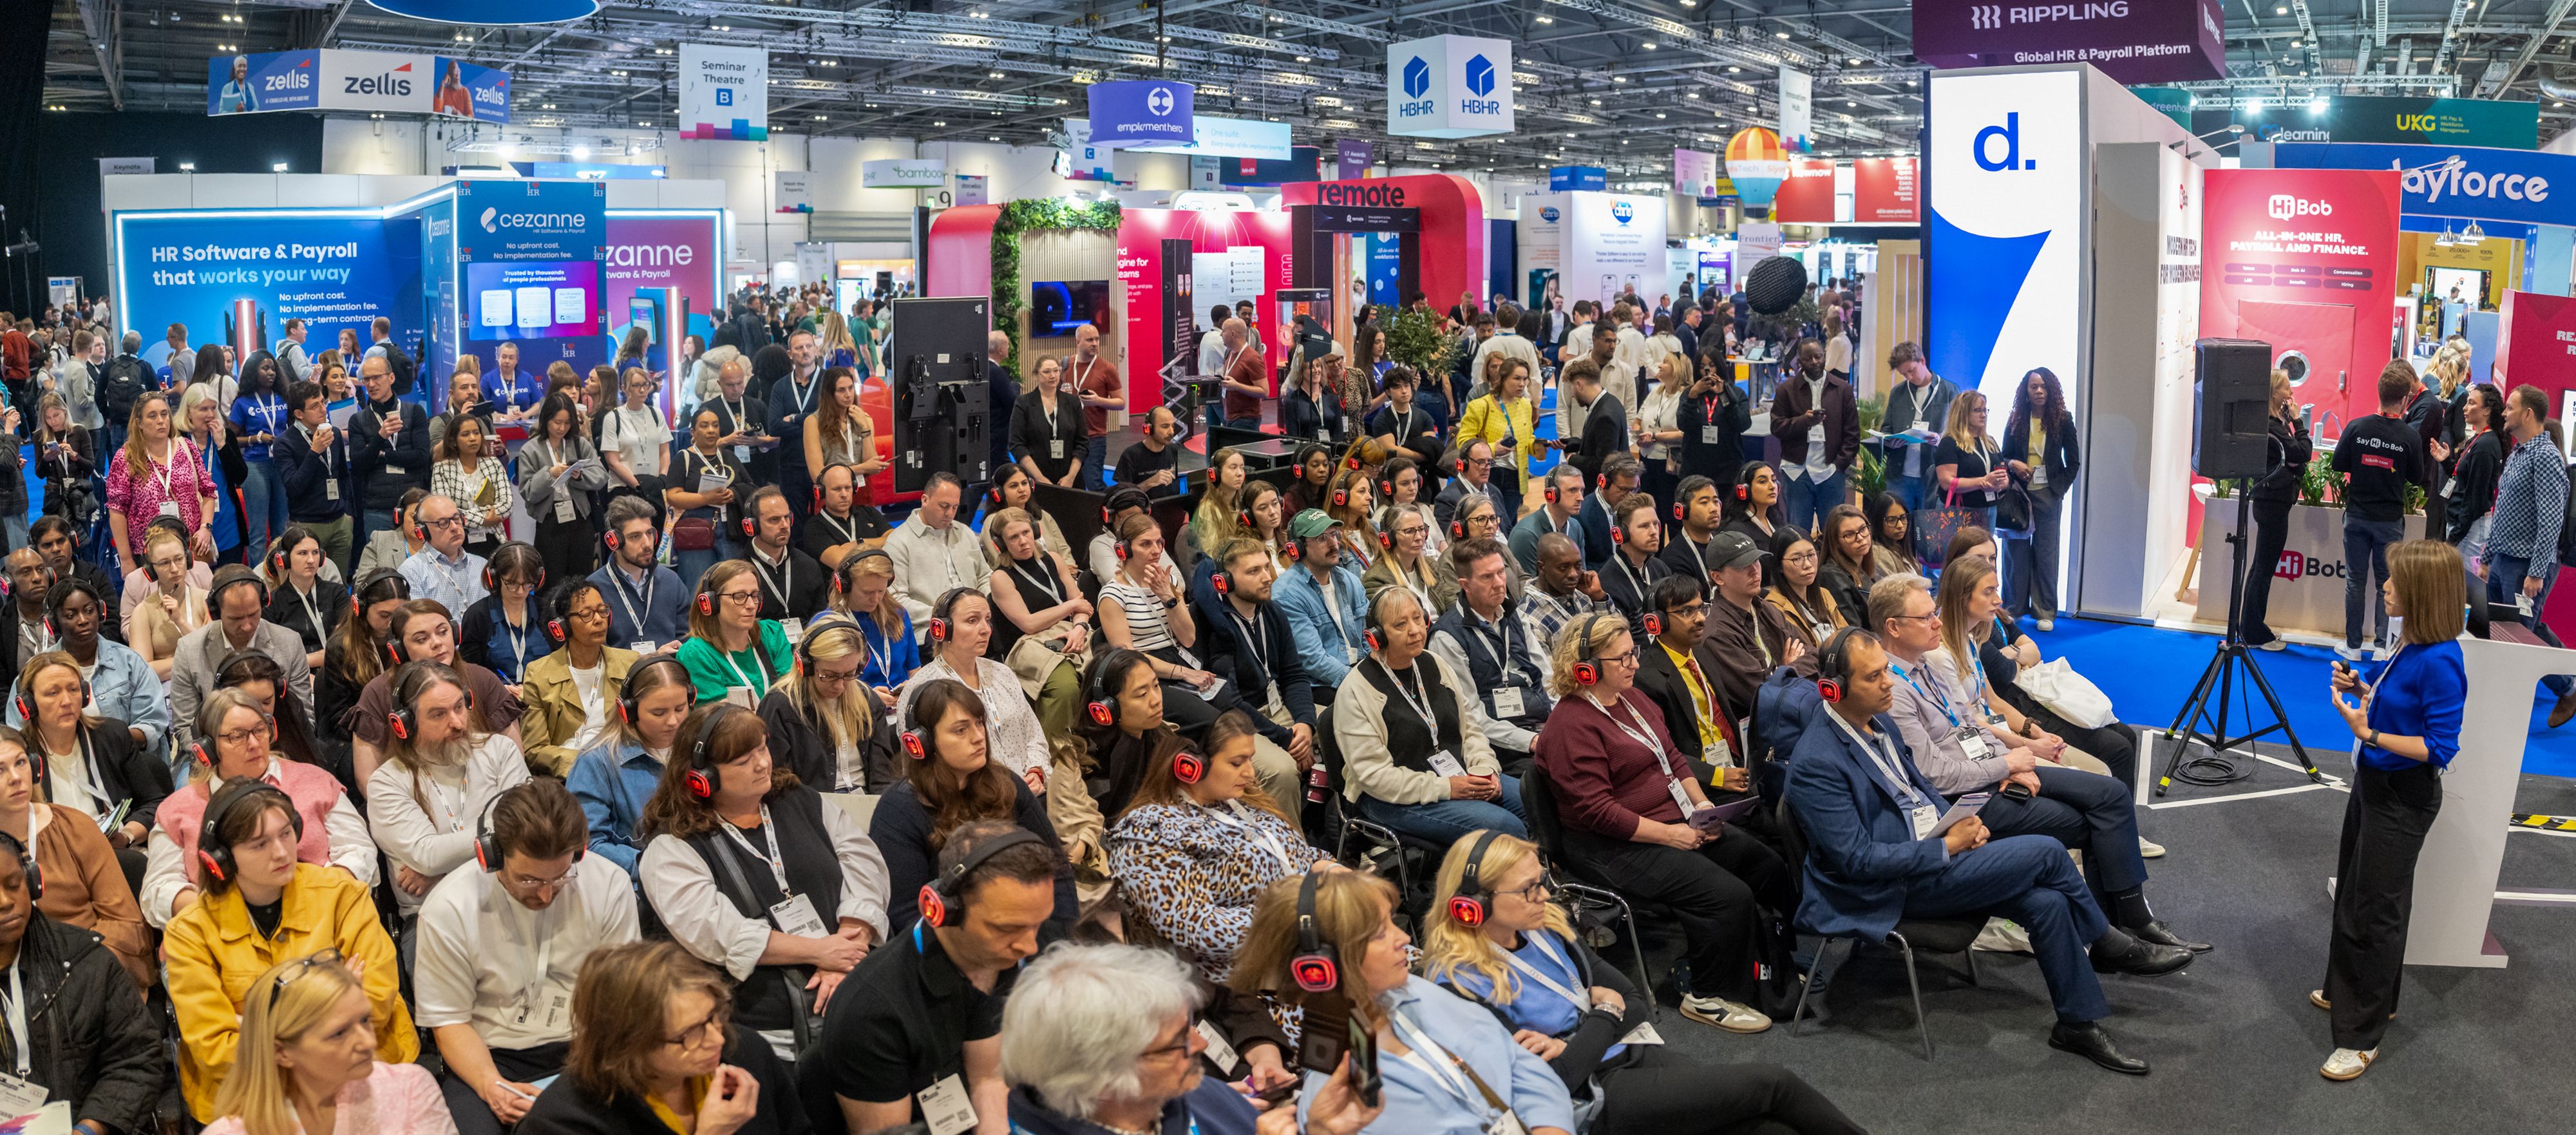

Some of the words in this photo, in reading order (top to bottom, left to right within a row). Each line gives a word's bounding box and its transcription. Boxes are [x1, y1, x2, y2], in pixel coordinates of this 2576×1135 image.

[2010, 1, 2128, 24] RIPPLING
[2014, 52, 2054, 63] Global
[2057, 50, 2075, 61] HR
[2079, 50, 2088, 61] &
[2090, 46, 2132, 62] Payroll
[2136, 44, 2190, 57] Platform
[702, 61, 746, 73] Seminar
[265, 68, 310, 91] zellis
[345, 72, 412, 96] zellis
[703, 73, 745, 85] Theatre
[475, 85, 504, 106] zellis
[719, 91, 730, 104] B
[1400, 100, 1434, 117] HBHR
[1463, 99, 1500, 115] HBHR
[2396, 114, 2436, 131] UKG
[1973, 111, 2036, 172] d.
[2388, 158, 2548, 204] ayforce
[940, 191, 951, 207] 9
[1318, 183, 1405, 207] remote
[2269, 195, 2333, 220] HiBob
[432, 218, 450, 237] cezanne
[500, 213, 585, 227] cezanne
[1739, 234, 1778, 243] Frontier
[2166, 234, 2183, 256] MODERN
[2255, 231, 2323, 242] ALL-IN-ONE
[2325, 234, 2345, 244] HR,
[151, 245, 178, 262] HR
[182, 244, 270, 262] Software
[274, 244, 289, 258] &
[292, 242, 358, 263] Payroll
[2231, 241, 2283, 252] PAYROLL
[2286, 243, 2311, 253] AND
[2313, 245, 2369, 256] FINANCE.
[1137, 258, 1149, 267] for
[153, 269, 196, 286] that
[199, 267, 258, 284] works
[262, 269, 307, 287] your
[310, 267, 351, 285] way
[633, 269, 640, 279] &
[642, 269, 670, 281] Payroll
[2160, 264, 2168, 285] FOR
[2169, 265, 2184, 284] MODERN
[2184, 264, 2200, 283] BUSINESS
[279, 293, 291, 301] No
[294, 292, 325, 303] upfront
[279, 305, 291, 313] No
[294, 303, 361, 314] implementation
[363, 302, 379, 311] fee.
[339, 314, 375, 324] contract
[256, 403, 289, 414] czanne
[2356, 437, 2370, 445] Say
[2391, 444, 2403, 452] Bob
